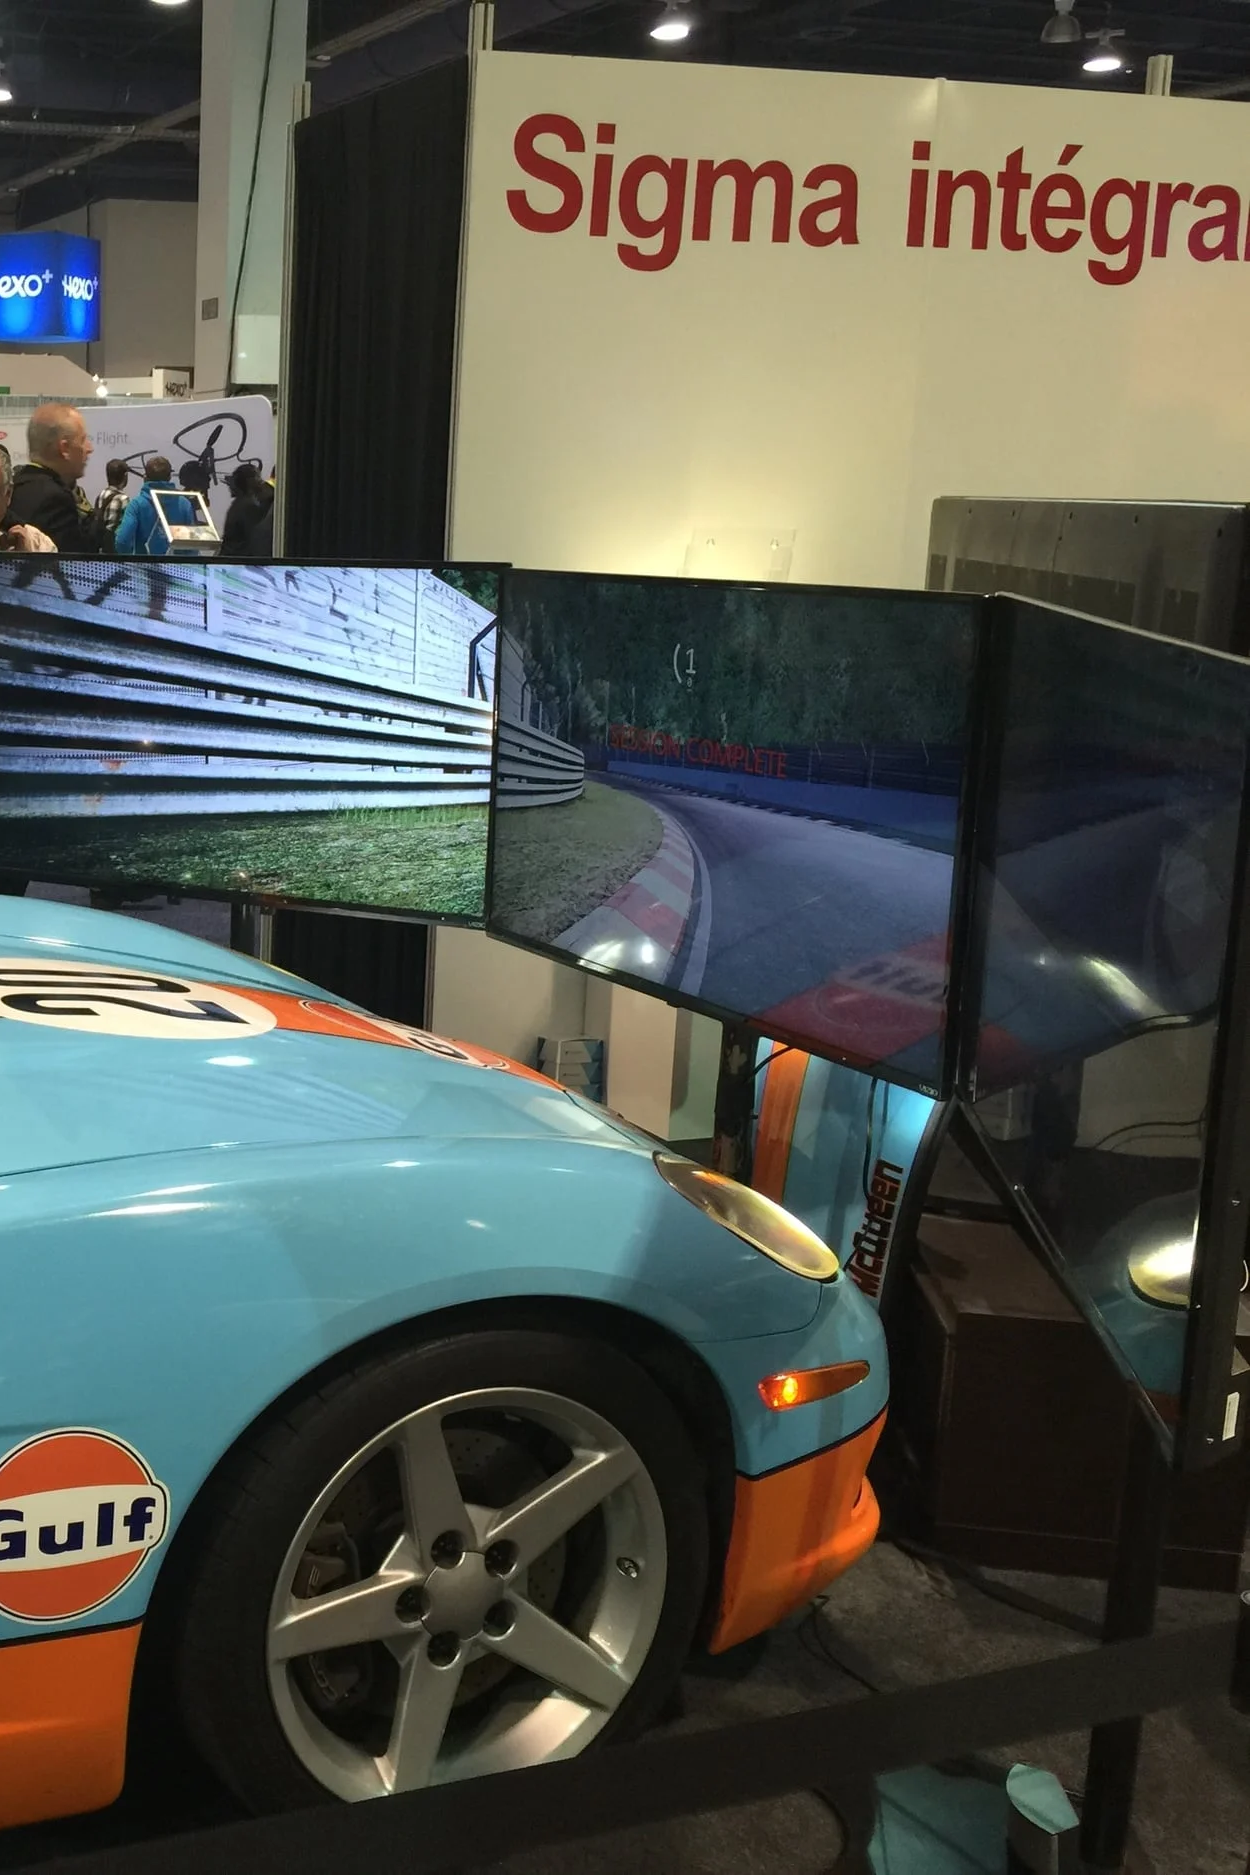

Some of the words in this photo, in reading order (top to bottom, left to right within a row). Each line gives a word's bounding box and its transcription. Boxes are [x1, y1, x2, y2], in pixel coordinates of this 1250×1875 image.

[506, 113, 860, 272] Sigma
[905, 140, 1250, 286] intégra
[609, 722, 681, 760] SESSION
[686, 736, 788, 780] COMPLETE
